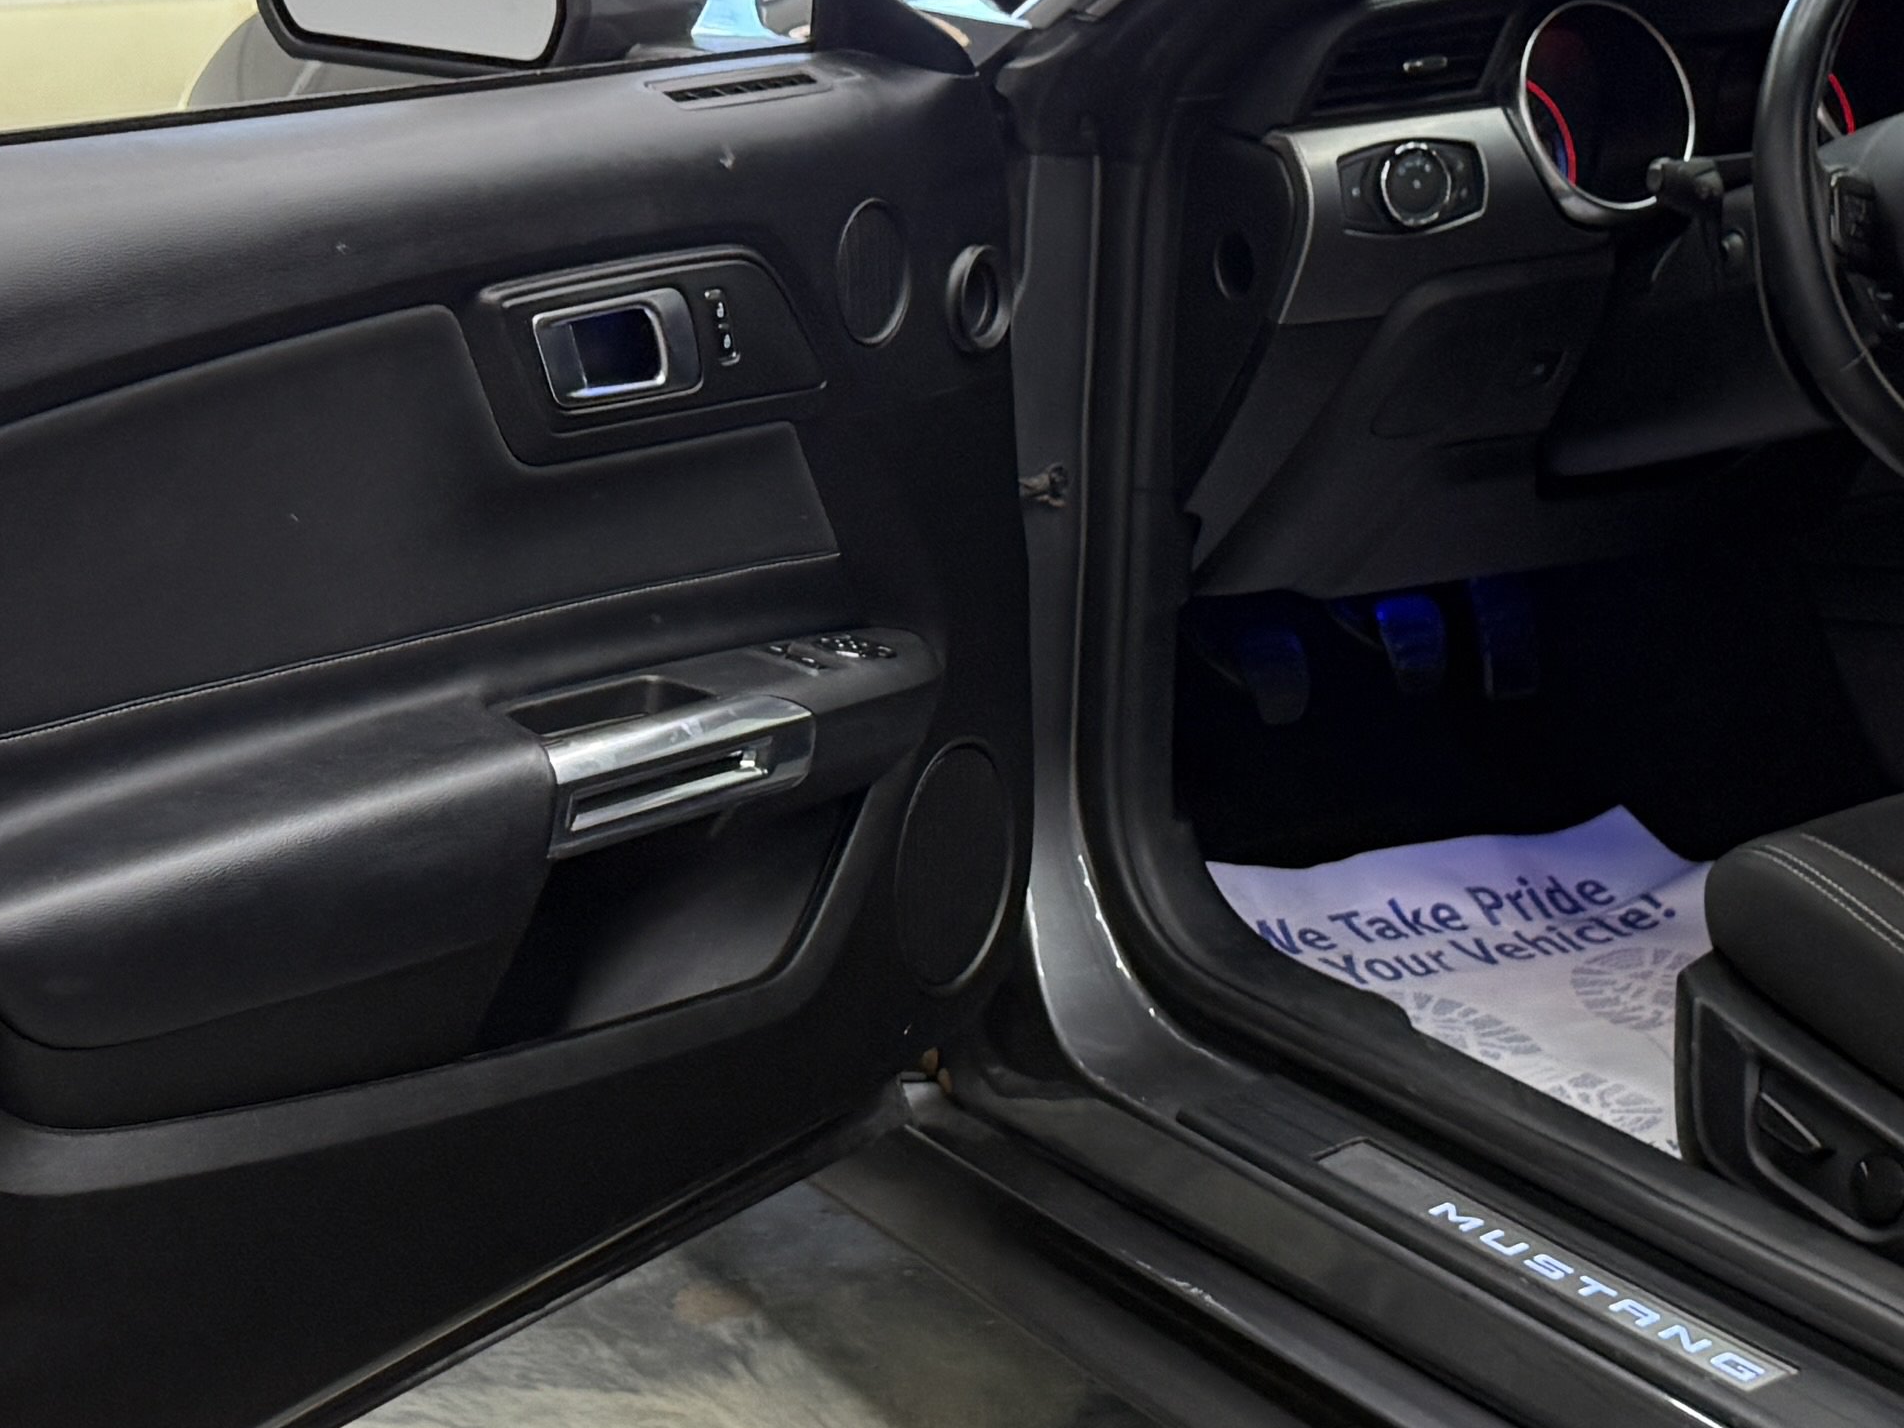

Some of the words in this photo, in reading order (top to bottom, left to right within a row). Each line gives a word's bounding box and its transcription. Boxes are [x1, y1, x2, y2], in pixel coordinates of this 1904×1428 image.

[1320, 949, 1459, 986] Your
[1449, 893, 1677, 968] Vehicle!
[1329, 898, 1469, 944] Take
[1465, 875, 1615, 927] Pride
[1427, 1200, 1768, 1384] MUSTANG
